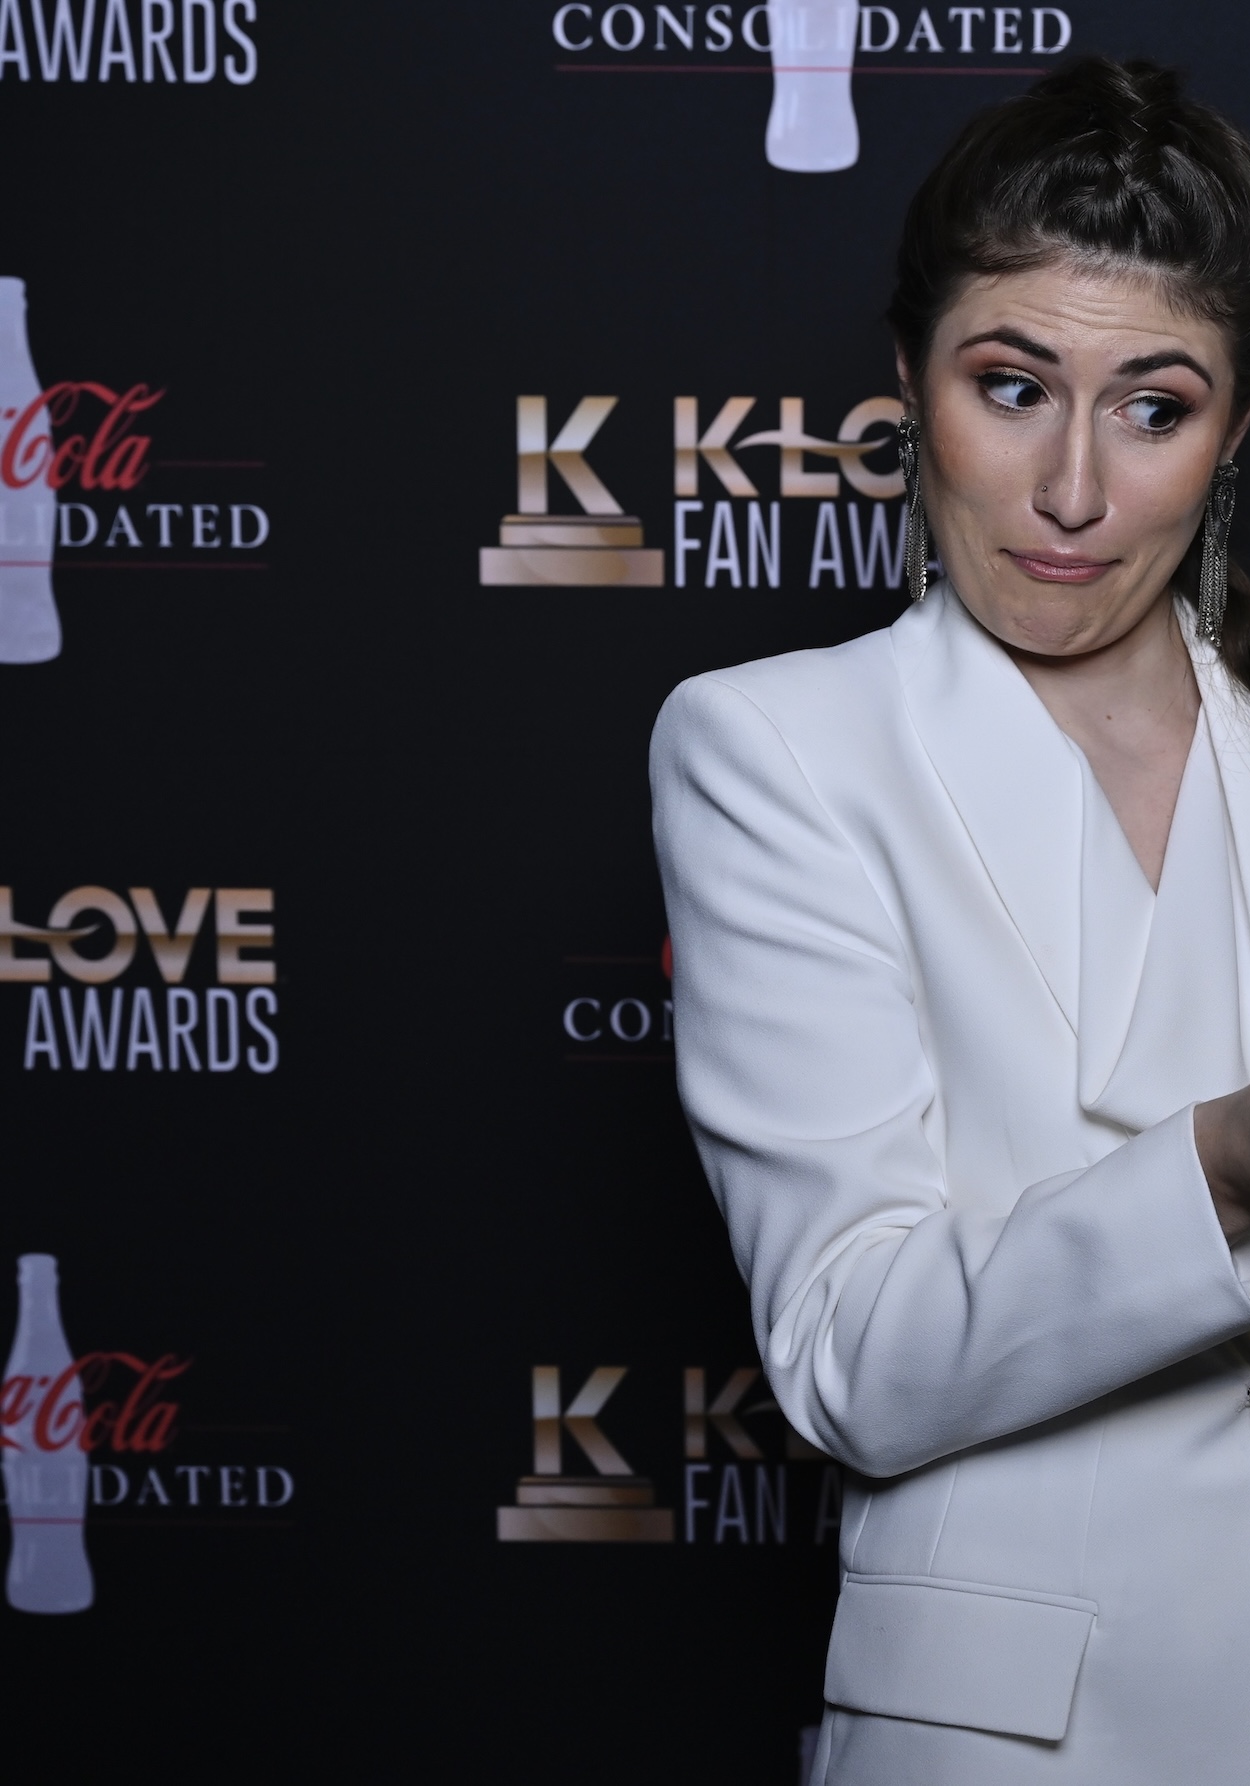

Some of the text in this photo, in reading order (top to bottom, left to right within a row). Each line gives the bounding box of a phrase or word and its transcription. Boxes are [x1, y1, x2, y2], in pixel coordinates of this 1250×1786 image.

[0, 0, 258, 85] AWARDS
[672, 500, 910, 590] FAN AW
[23, 984, 281, 1075] AWARDS
[684, 1462, 788, 1545] FAN
